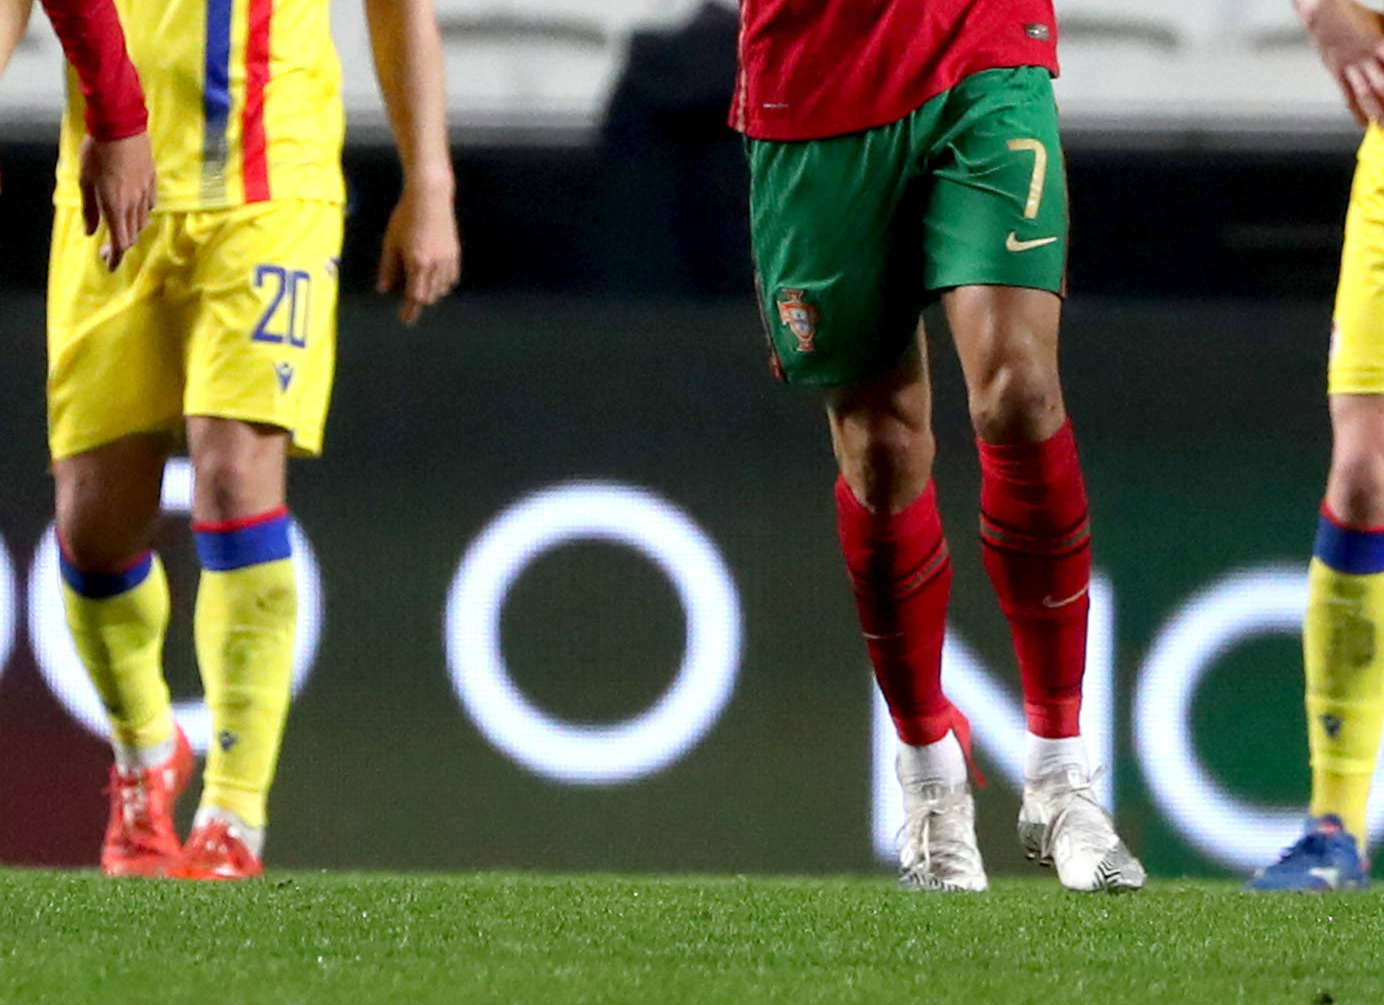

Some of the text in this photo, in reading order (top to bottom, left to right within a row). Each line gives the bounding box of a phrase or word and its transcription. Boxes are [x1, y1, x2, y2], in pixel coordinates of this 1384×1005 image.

[1007, 138, 1047, 219] 7
[250, 264, 311, 349] 20
[443, 479, 744, 785] O
